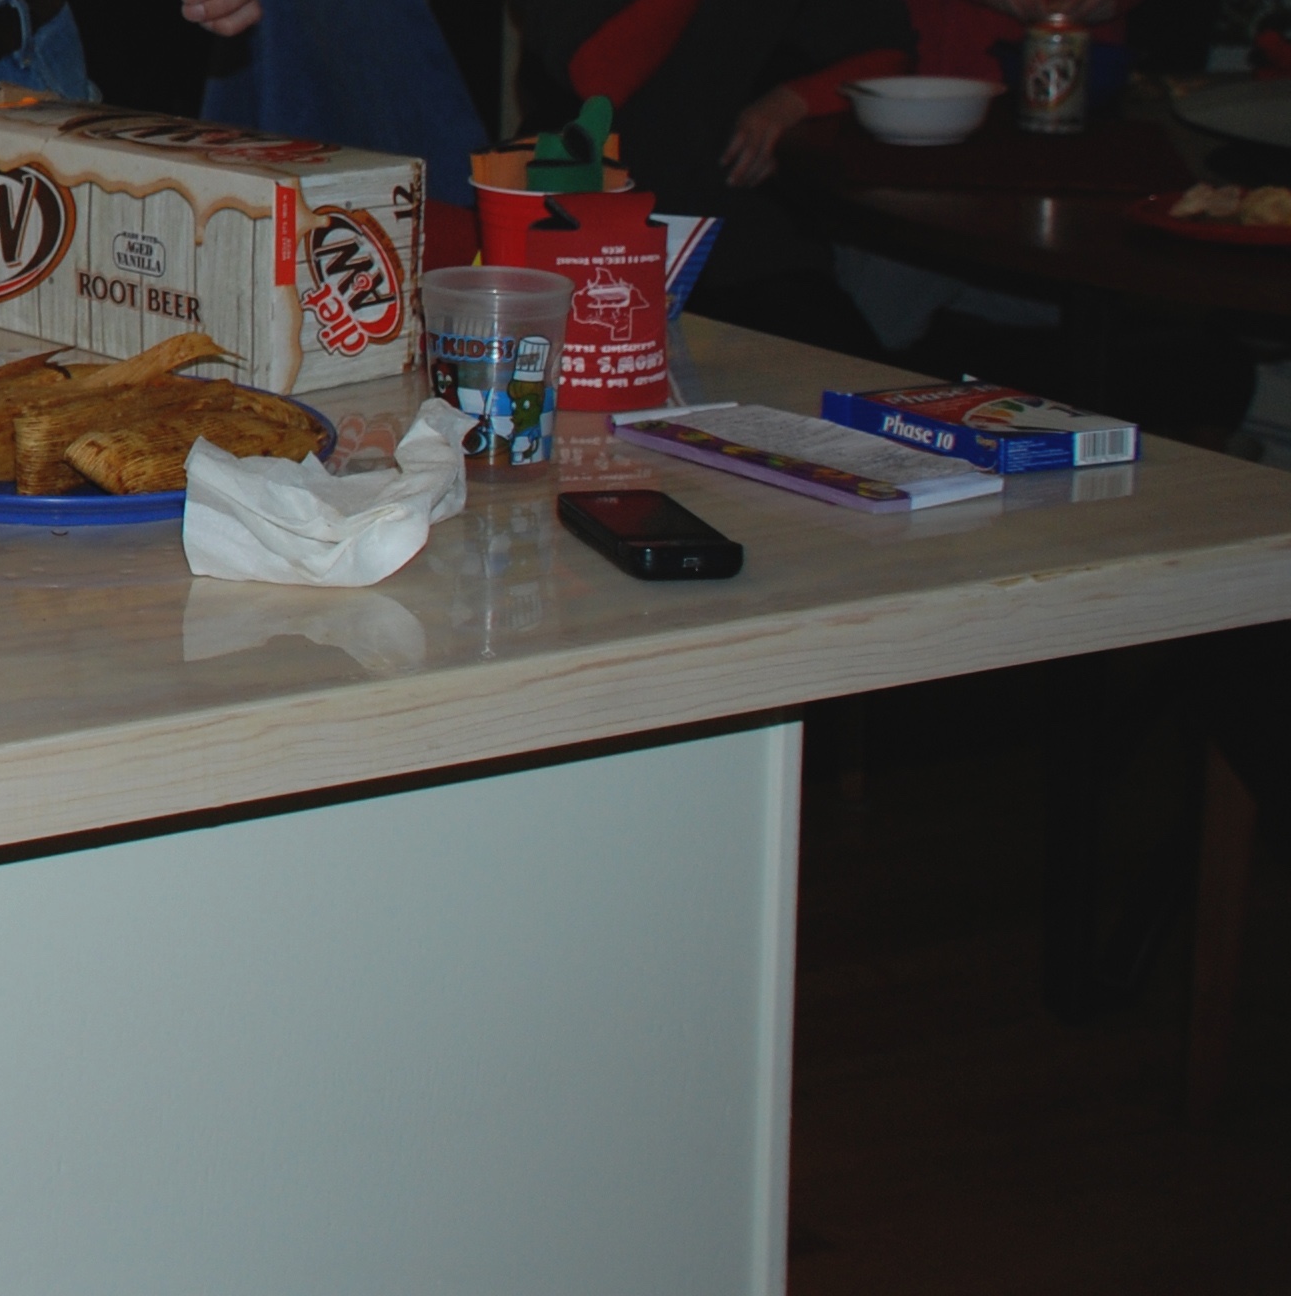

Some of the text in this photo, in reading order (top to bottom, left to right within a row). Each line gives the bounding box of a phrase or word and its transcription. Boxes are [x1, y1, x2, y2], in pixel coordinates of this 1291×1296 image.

[116, 251, 161, 273] VANILLA
[126, 241, 153, 257] AGED
[314, 236, 397, 311] A&W
[79, 272, 201, 323] ROOT BEER
[302, 284, 366, 353] diet
[441, 334, 515, 360] KIDS!
[883, 413, 933, 445] Phase
[936, 430, 956, 452] 10
